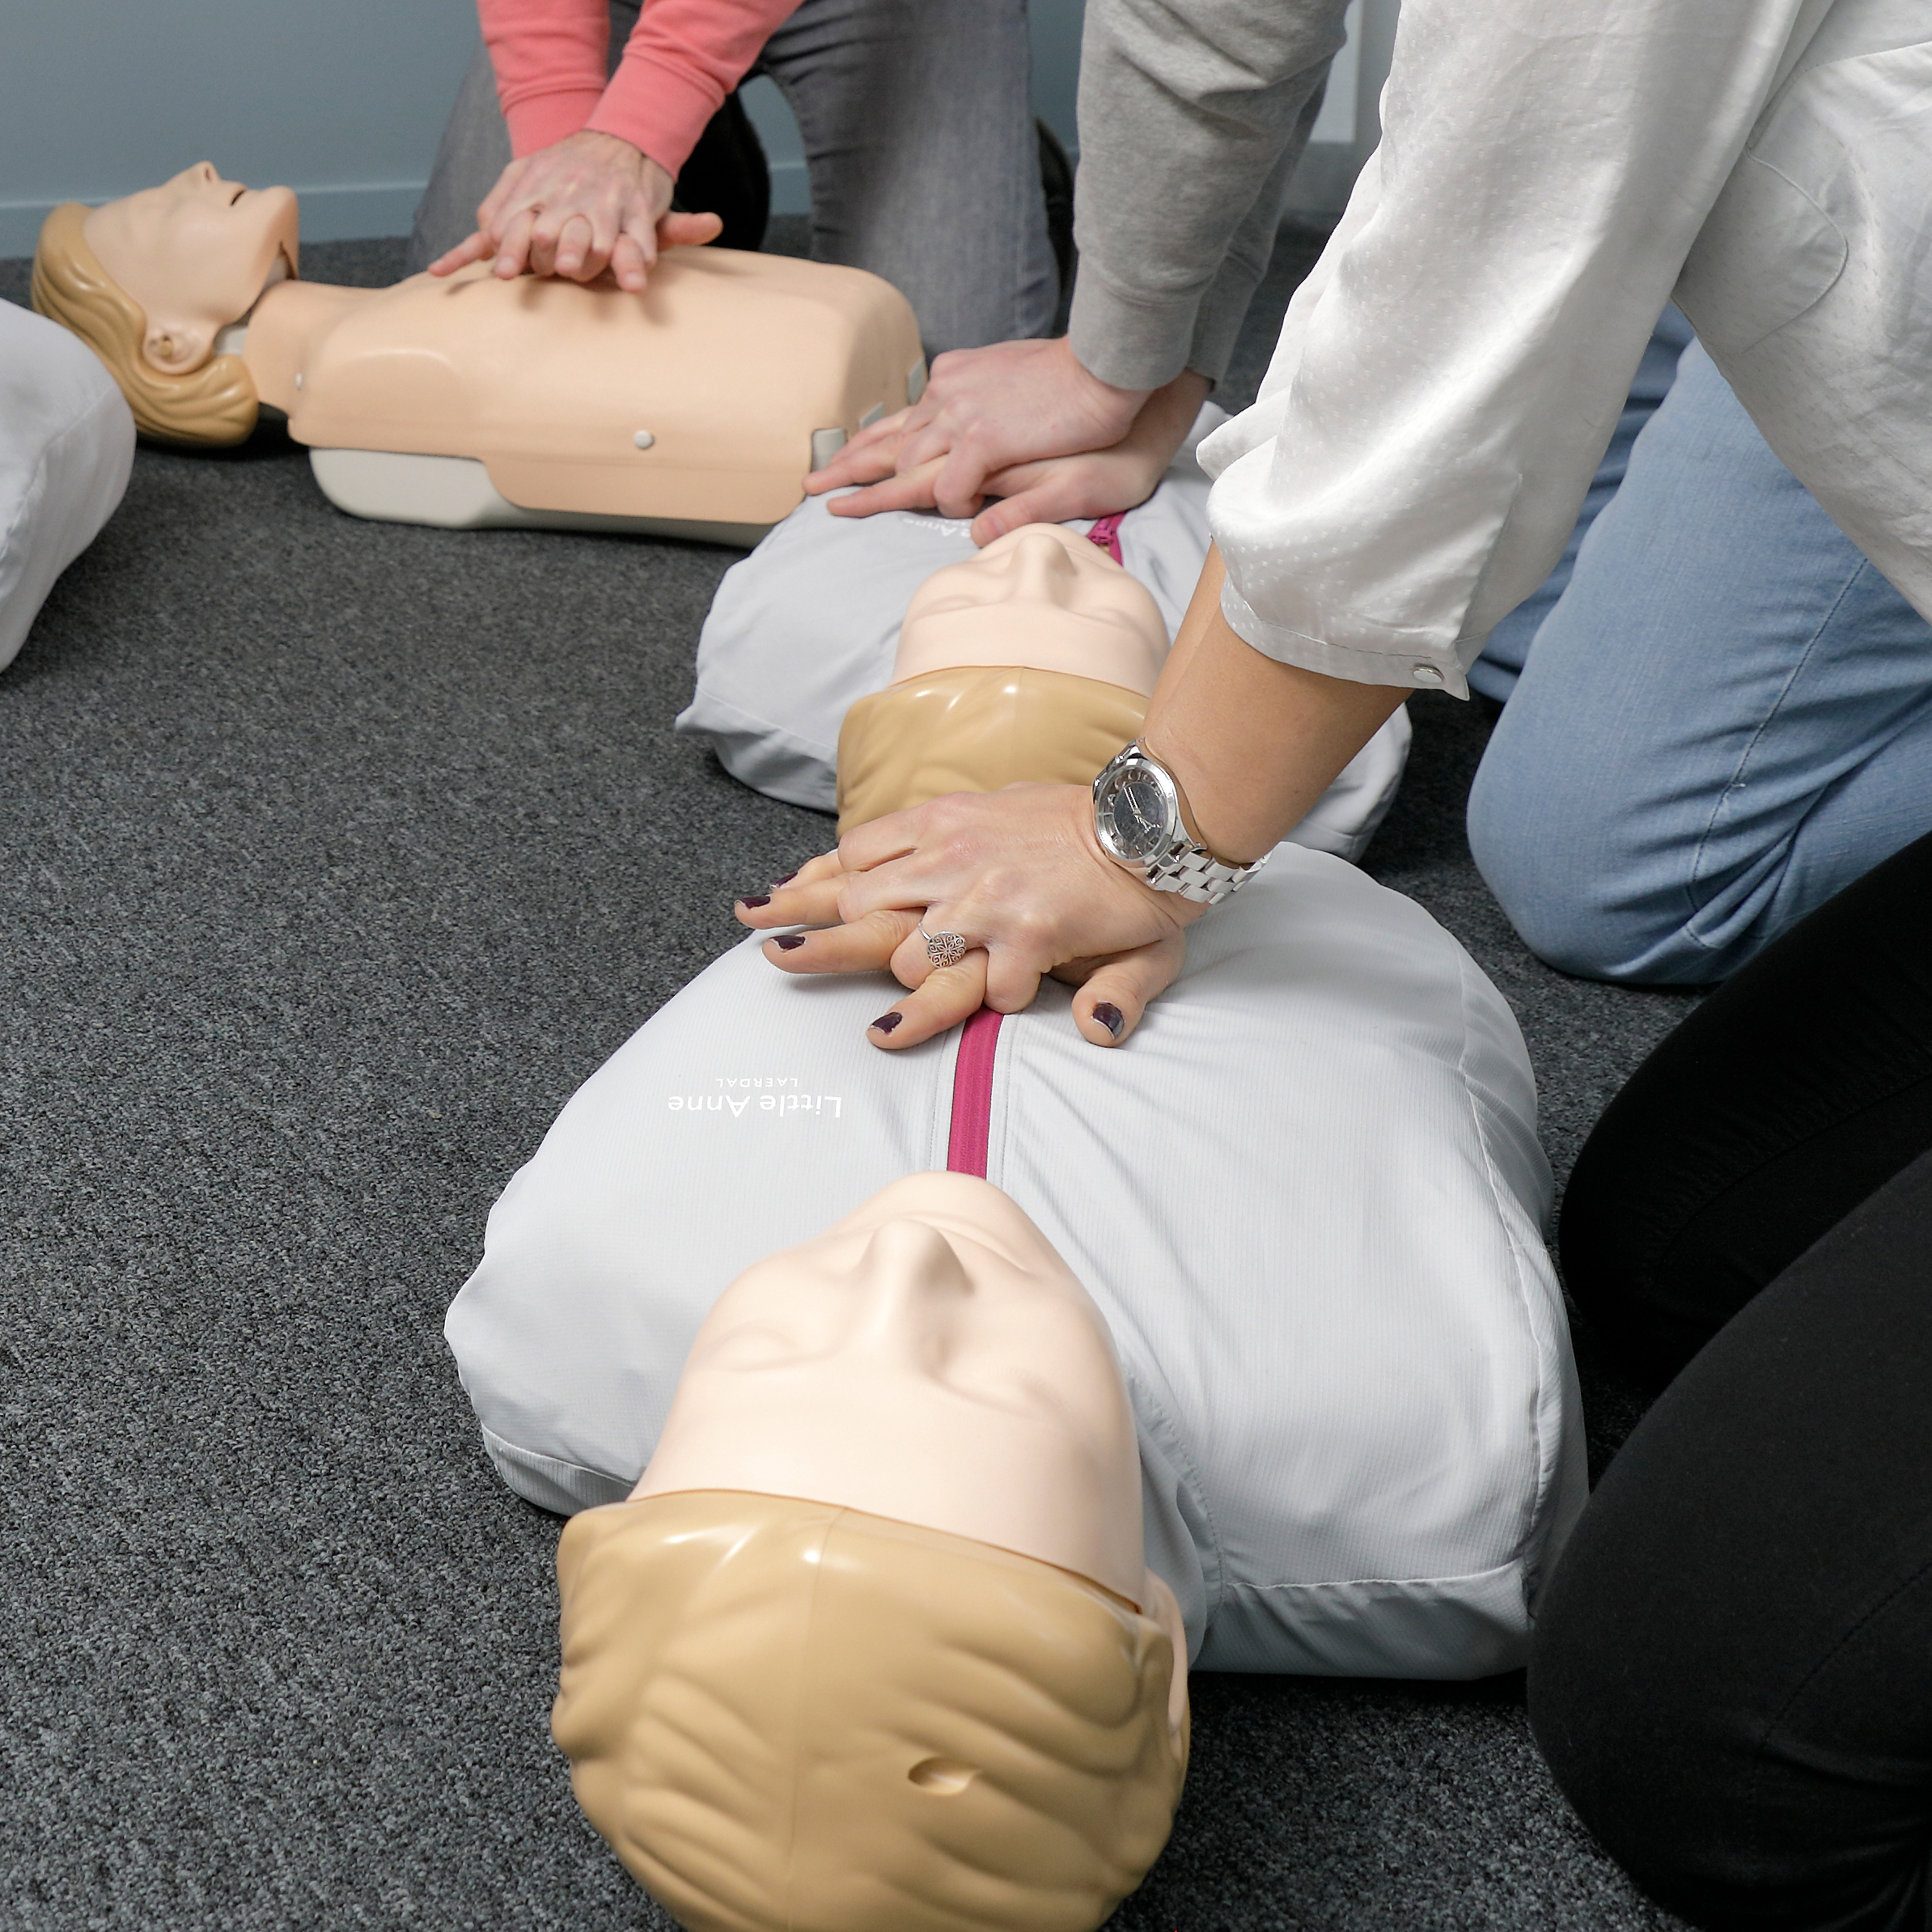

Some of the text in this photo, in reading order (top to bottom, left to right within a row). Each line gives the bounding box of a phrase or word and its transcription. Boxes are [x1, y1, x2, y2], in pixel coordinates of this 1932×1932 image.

[903, 518, 957, 536] Anne
[716, 1078, 799, 1087] LAERDAL
[667, 1095, 841, 1117] Little Anne
